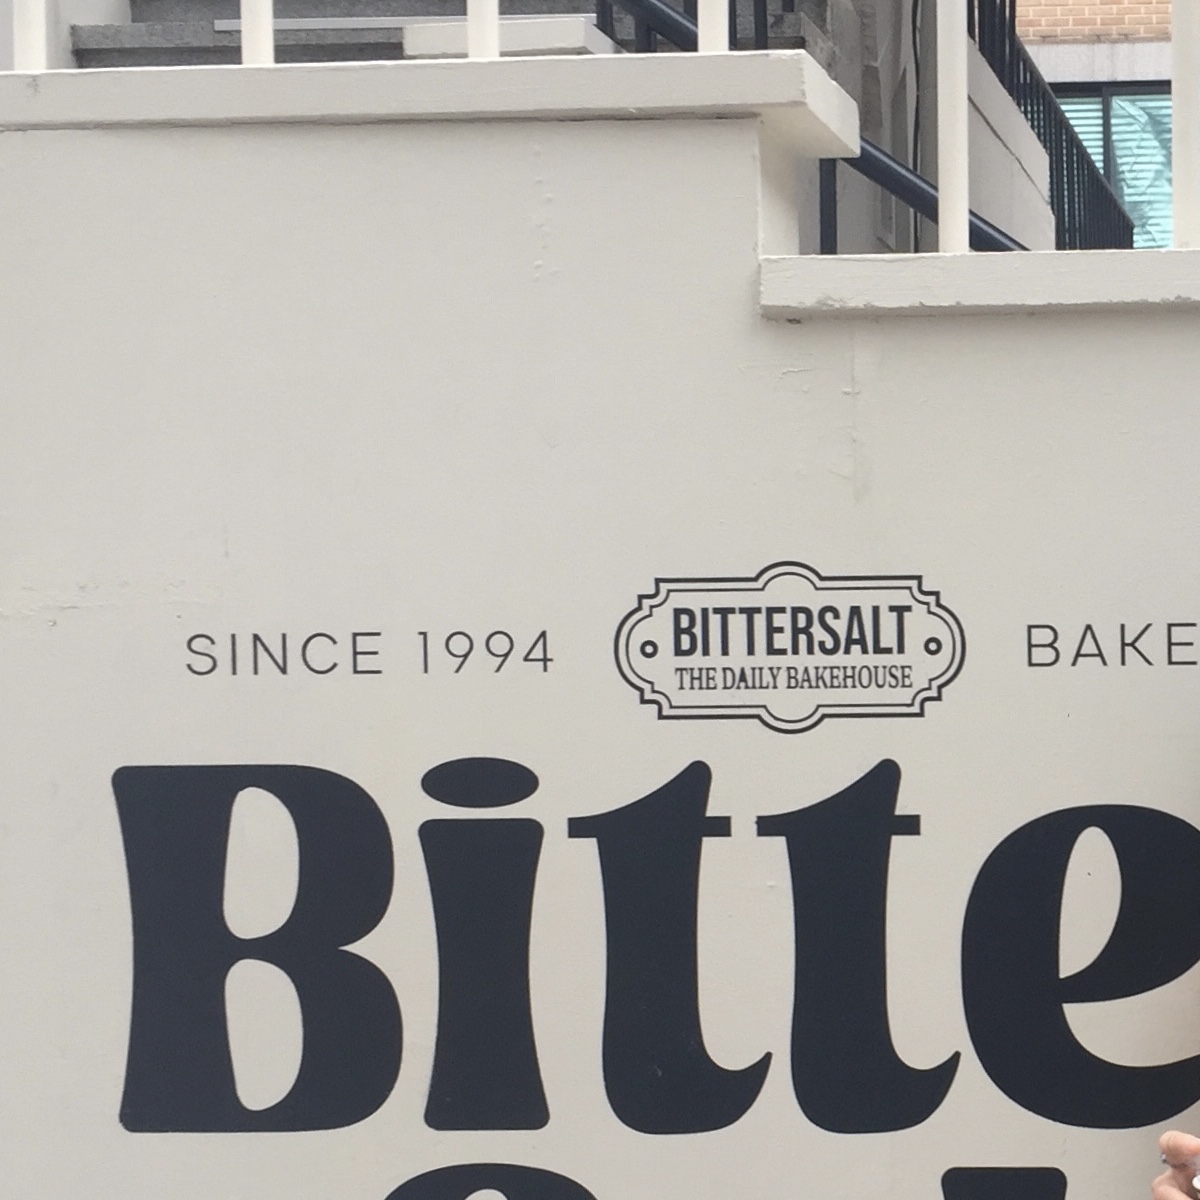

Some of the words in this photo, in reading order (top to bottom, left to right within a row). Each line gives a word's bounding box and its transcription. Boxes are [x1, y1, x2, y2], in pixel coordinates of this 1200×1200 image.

[186, 631, 382, 676] SINCE
[418, 630, 555, 674] 1994
[673, 605, 913, 657] BITTERSALT
[675, 667, 717, 690] THE
[721, 666, 782, 690] DAILY
[786, 665, 914, 689] BAKEHOUSE
